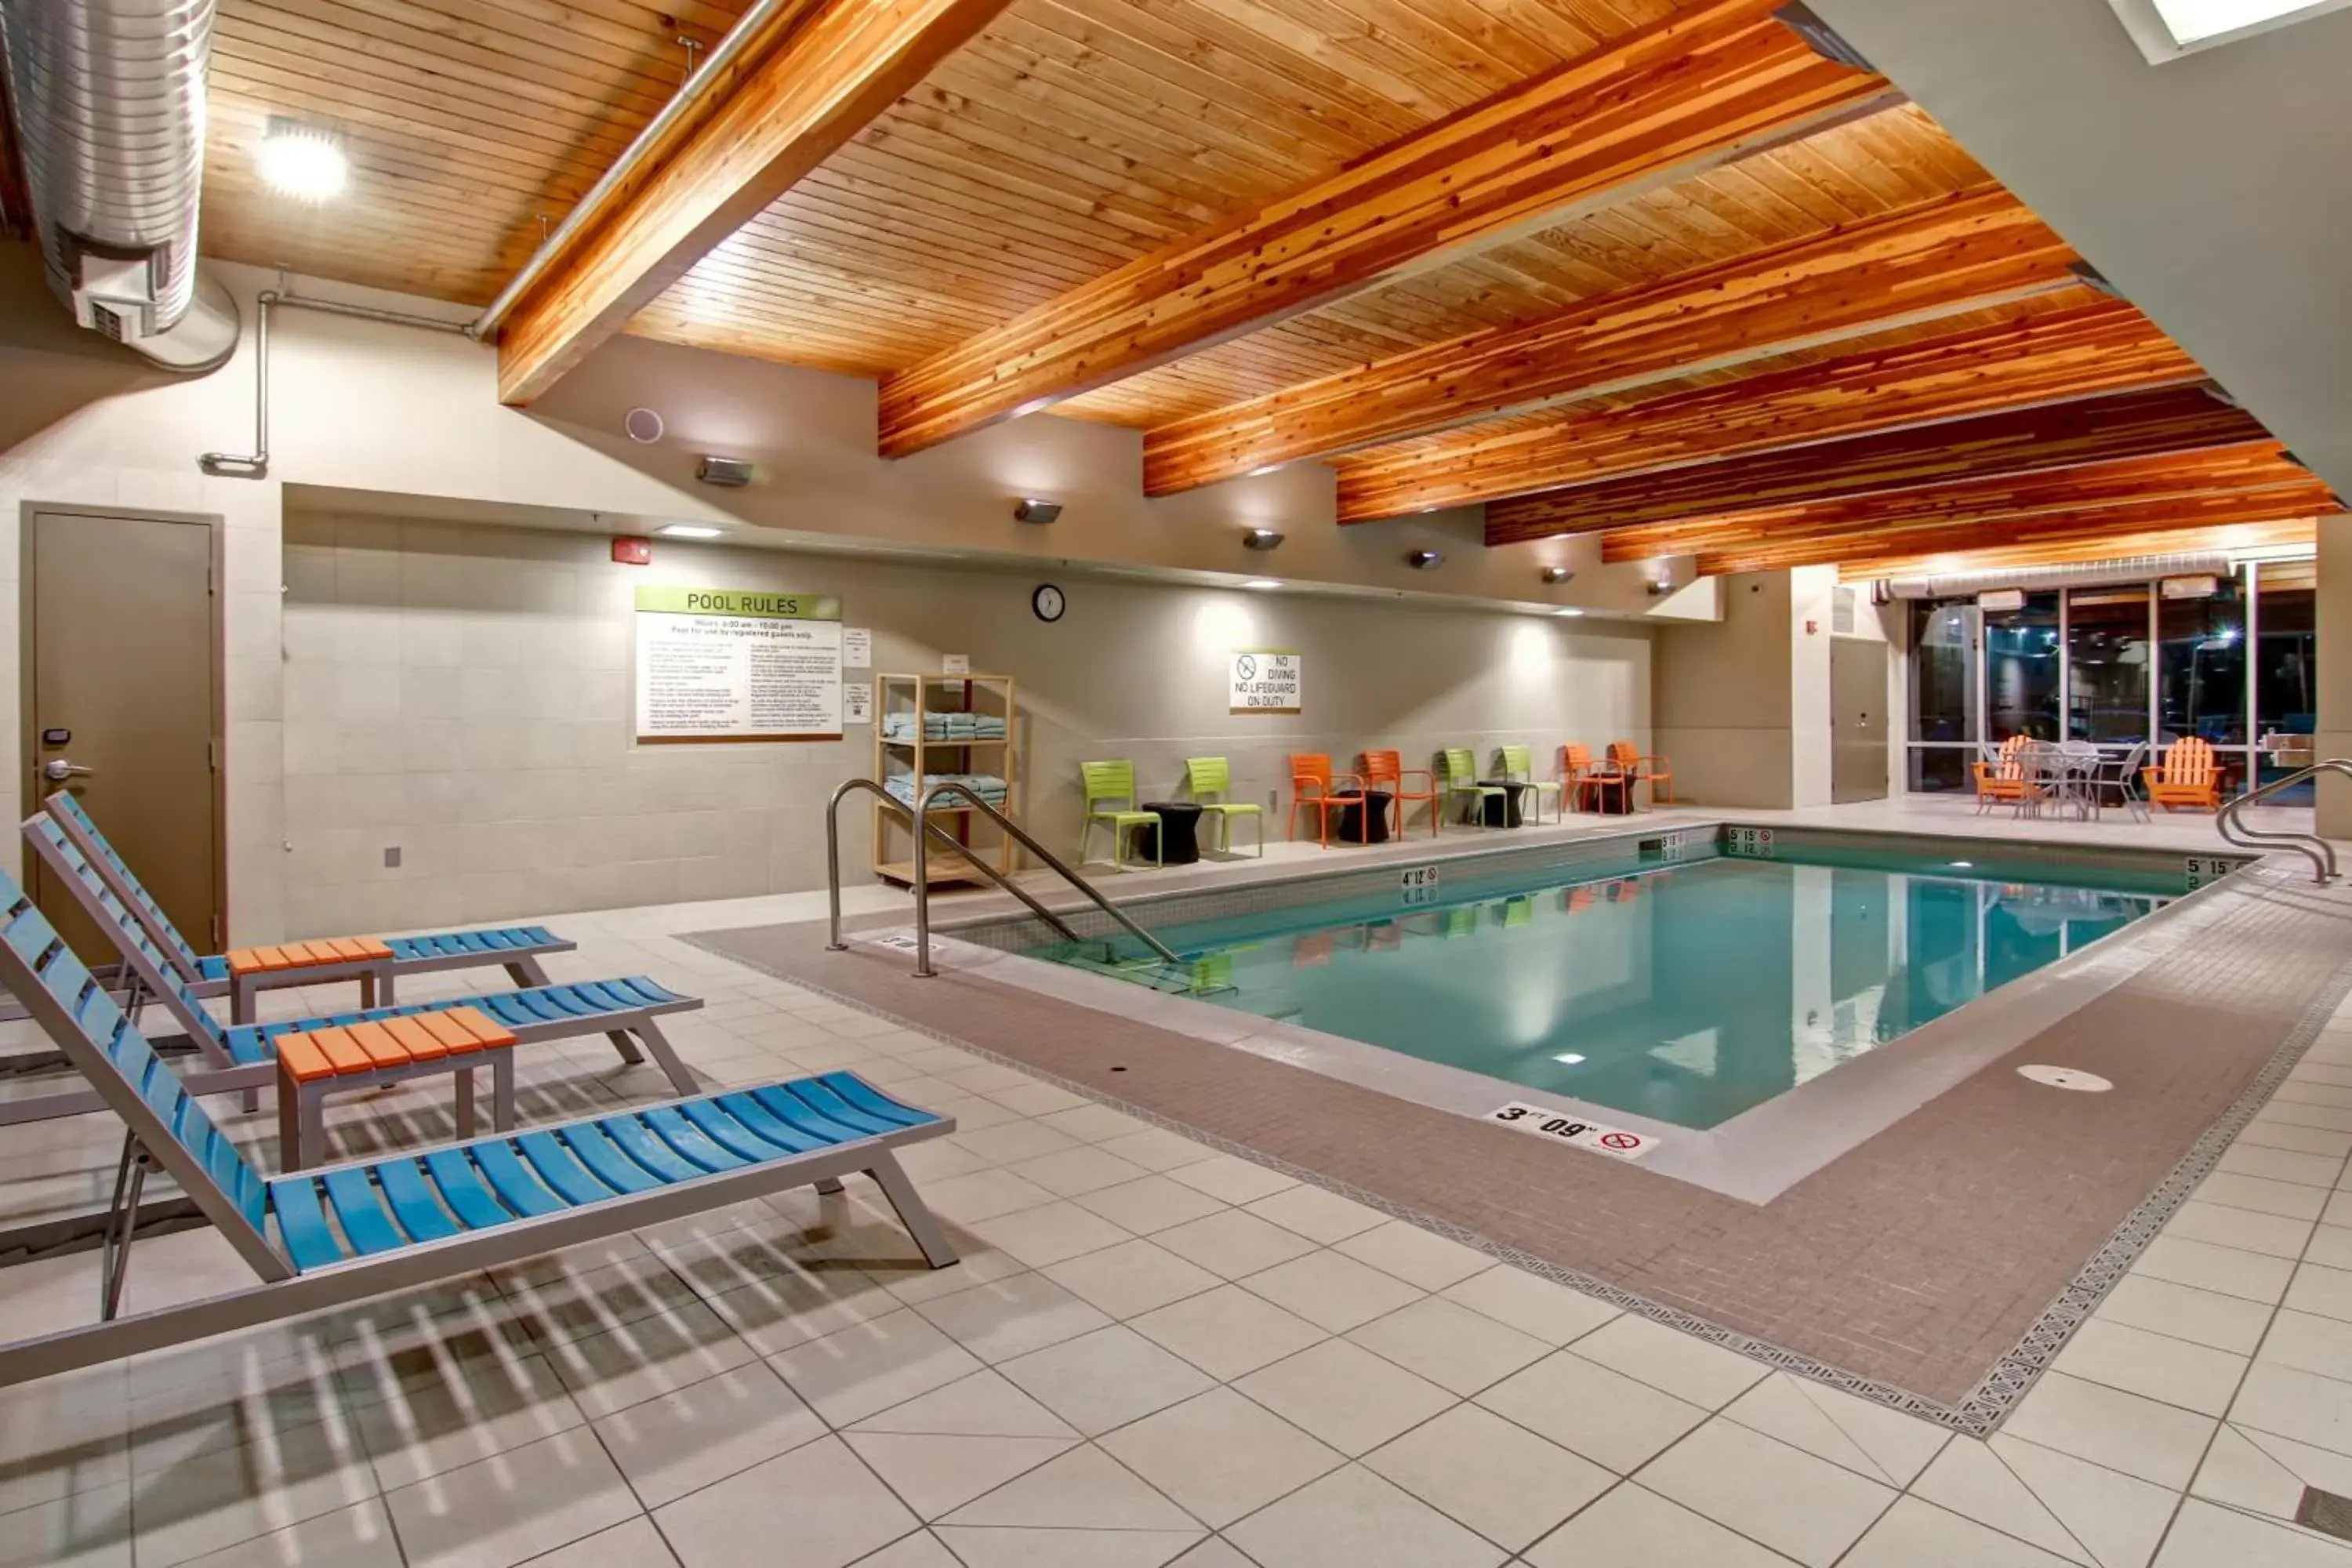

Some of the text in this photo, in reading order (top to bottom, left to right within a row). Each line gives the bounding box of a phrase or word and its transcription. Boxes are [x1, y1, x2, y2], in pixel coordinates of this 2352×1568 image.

[687, 593, 798, 614] POOL RULES
[730, 629, 769, 637] registered
[1275, 655, 1289, 667] NO
[1267, 669, 1296, 681] DIVING
[1235, 682, 1296, 694] NO LIFEGUARD
[1247, 695, 1285, 706] ON DUTY
[1730, 829, 1738, 840] 5
[2188, 859, 2227, 874] 5 15
[1403, 871, 1410, 887] 4
[1496, 1108, 1528, 1120] 3
